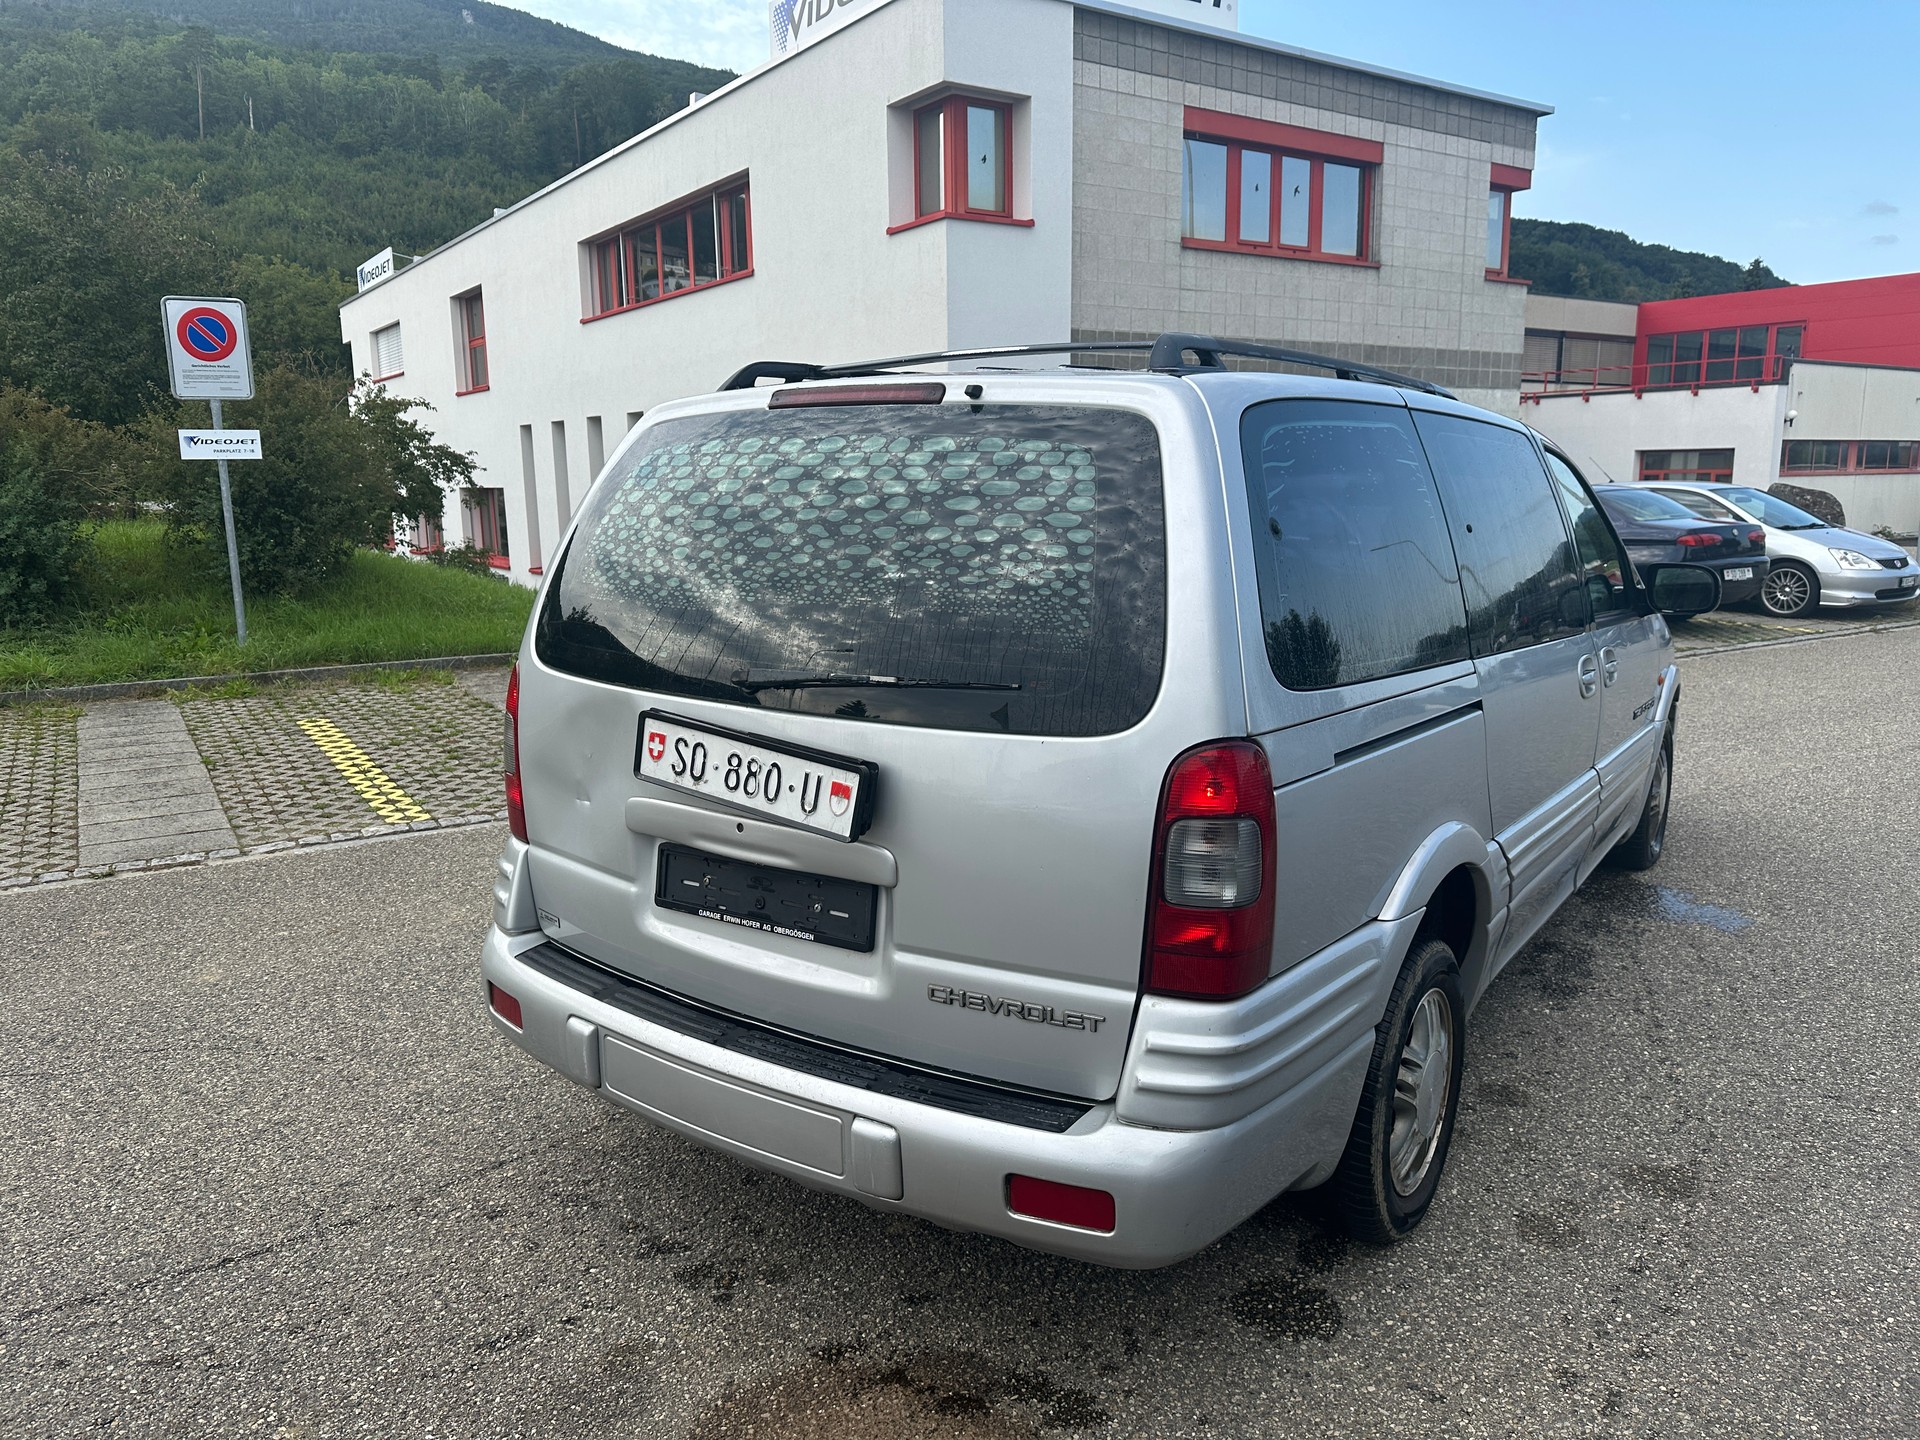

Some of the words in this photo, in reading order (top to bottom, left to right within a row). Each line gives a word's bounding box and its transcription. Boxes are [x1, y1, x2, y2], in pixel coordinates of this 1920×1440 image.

[361, 258, 390, 288] VIDEOJET
[190, 438, 257, 446] VIDEOJET
[698, 909, 721, 920] GARAGE
[723, 914, 741, 925] ERWIN
[741, 919, 761, 929] HOFER
[762, 923, 772, 932] AG
[773, 925, 815, 941] OBERGÖSGEN
[927, 983, 1106, 1033] CHEVROLET
